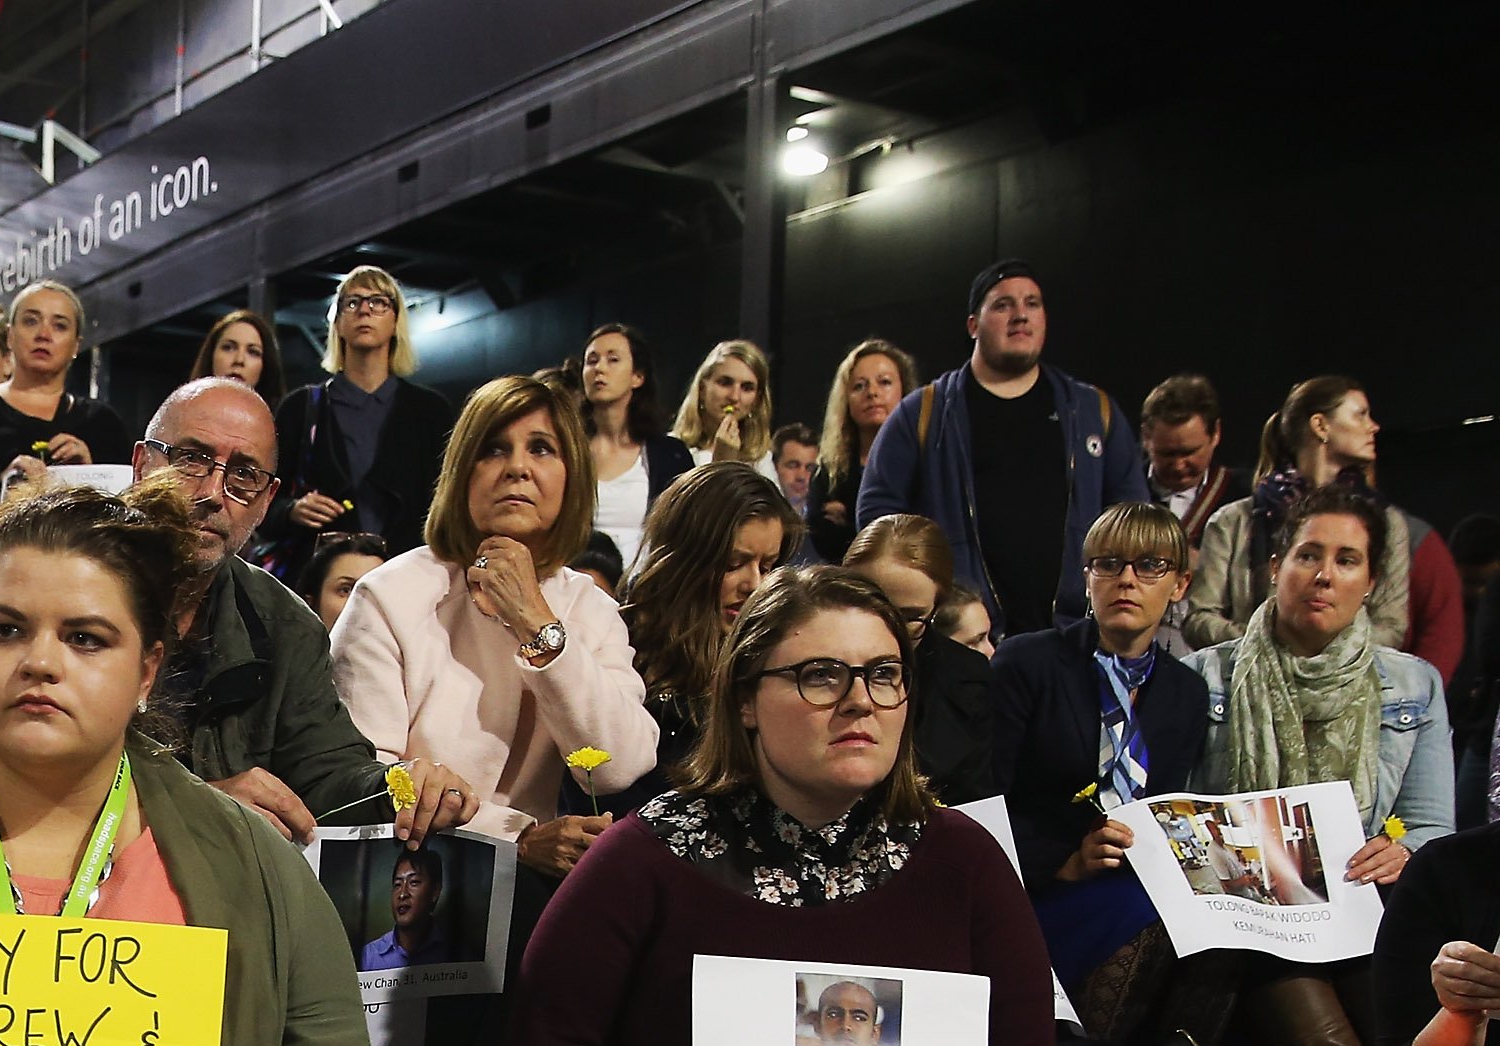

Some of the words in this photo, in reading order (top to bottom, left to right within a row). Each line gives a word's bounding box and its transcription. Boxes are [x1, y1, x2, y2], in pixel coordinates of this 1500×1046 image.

[78, 194, 104, 256] of
[108, 191, 141, 241] an
[150, 156, 218, 222] icon.
[77, 813, 117, 897] headspace.org.au
[1206, 900, 1250, 914] TOLONG
[1278, 910, 1331, 923] WIDODO
[1233, 920, 1288, 942] KEMRAHAN
[1291, 932, 1316, 943] HATI
[54, 927, 157, 998] FOR
[422, 970, 468, 983] Australia
